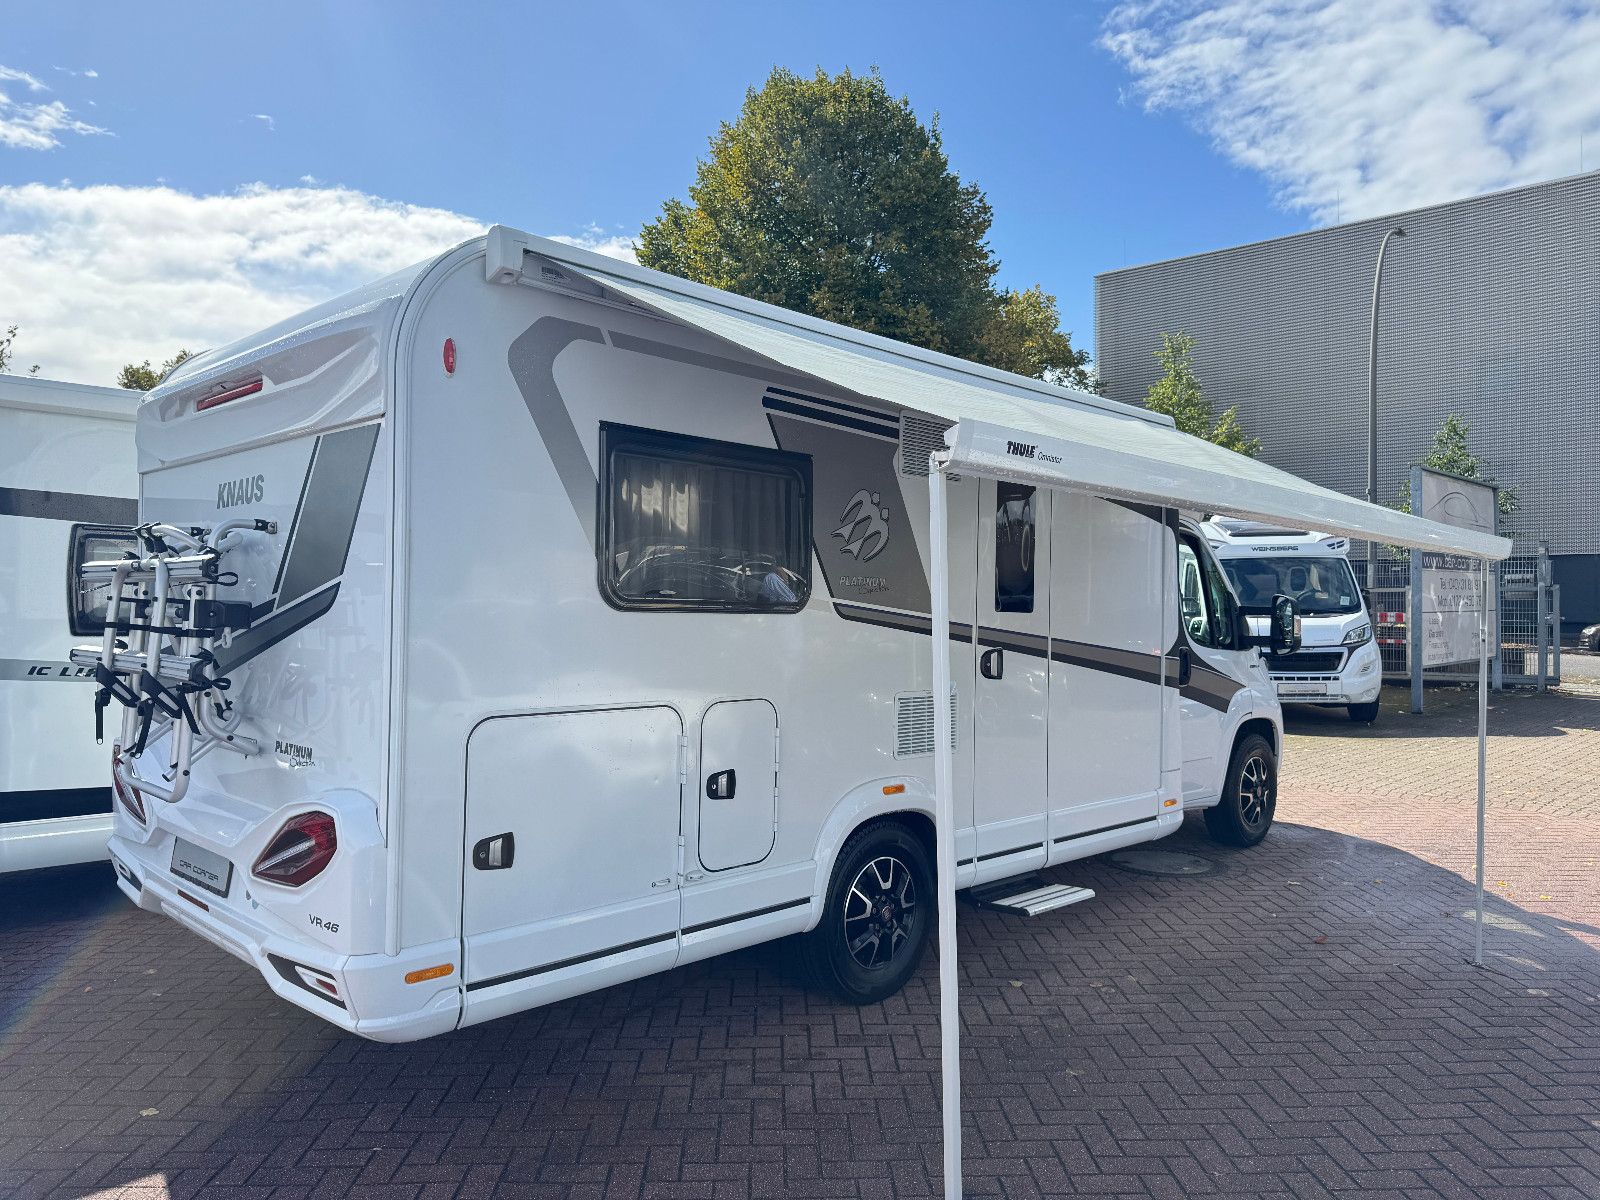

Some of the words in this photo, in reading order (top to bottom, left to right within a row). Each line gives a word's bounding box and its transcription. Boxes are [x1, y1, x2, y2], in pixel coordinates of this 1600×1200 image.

[1006, 440, 1036, 459] THULE
[216, 473, 265, 510] KNAUS
[839, 575, 887, 588] PLATINUM
[27, 665, 52, 676] IC
[274, 740, 313, 761] PLATINUM
[179, 859, 192, 869] CAR
